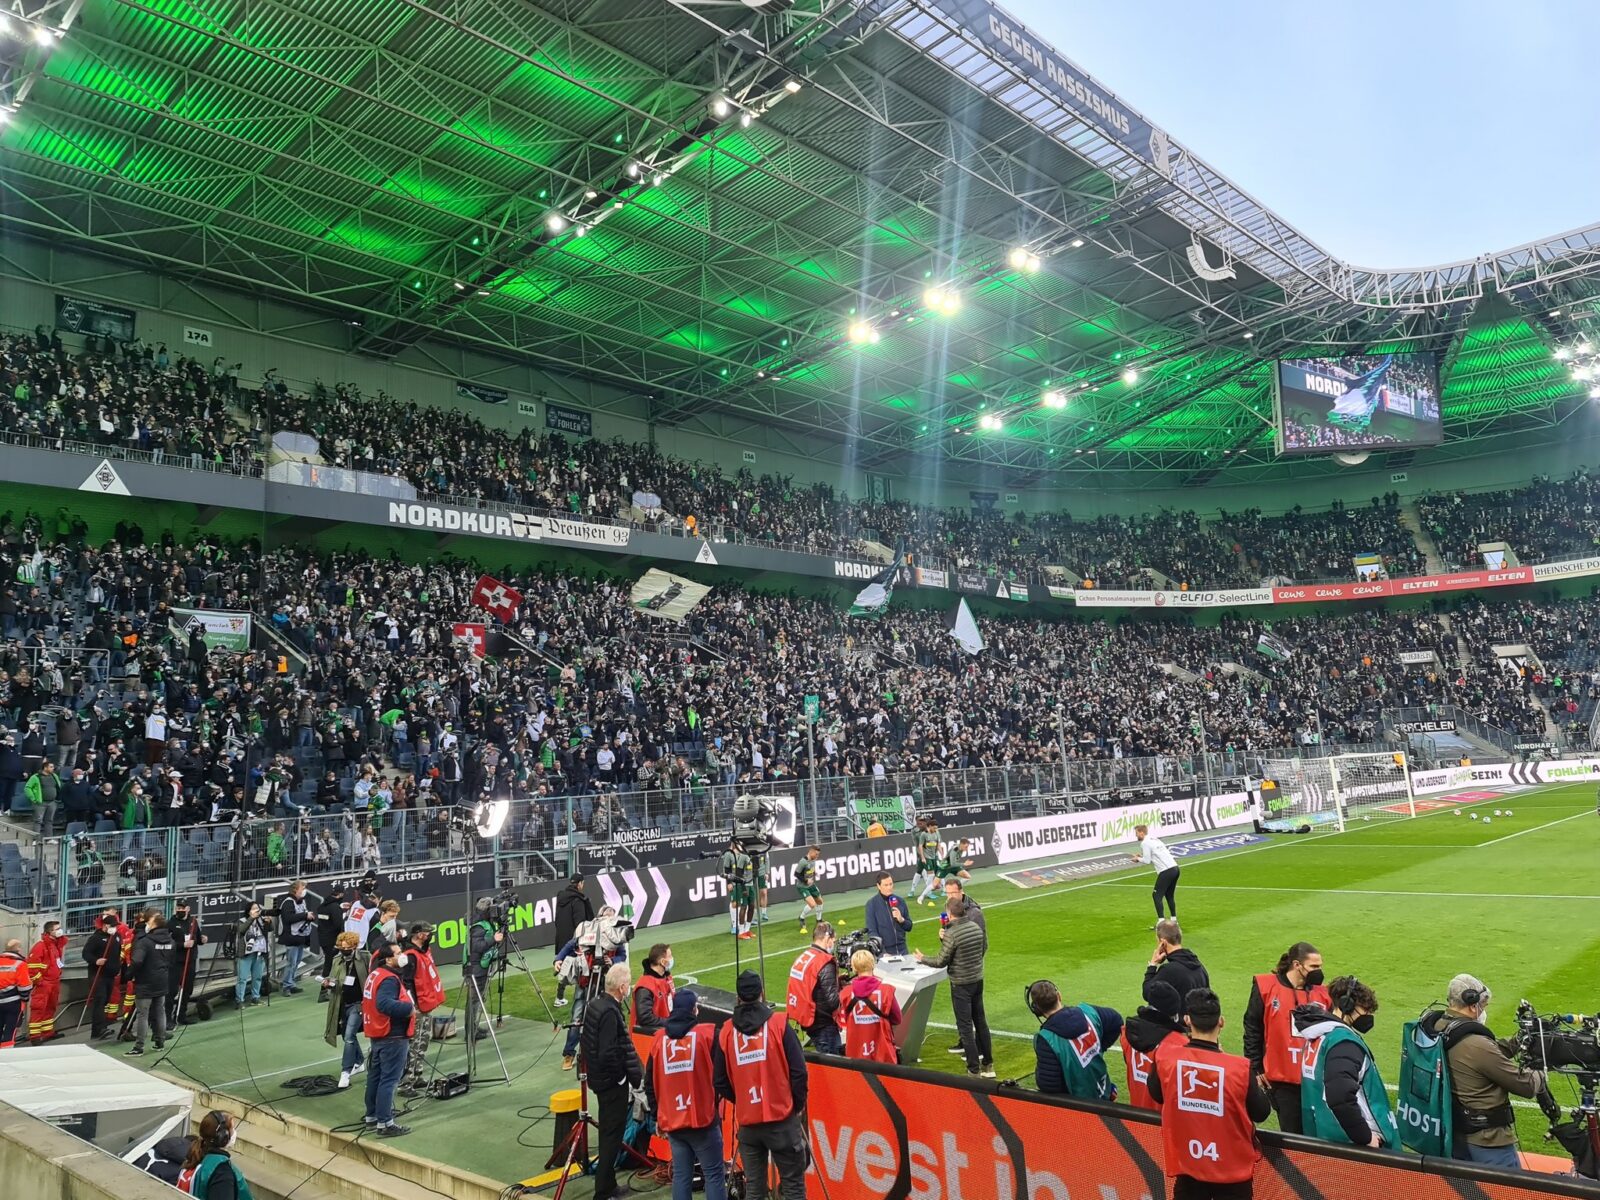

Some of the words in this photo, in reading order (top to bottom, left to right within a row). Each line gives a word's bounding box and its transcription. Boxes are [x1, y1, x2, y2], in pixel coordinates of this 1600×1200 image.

[989, 14, 1044, 71] GEGEN
[1046, 57, 1130, 135] RASSISMUS
[187, 330, 209, 342] 17A
[389, 502, 542, 540] NORDKUR
[1535, 563, 1584, 577] RHEINISCHE
[1488, 572, 1526, 582] ELTEN
[1352, 585, 1383, 595] cewe
[1402, 579, 1439, 590] ELTEN
[1219, 592, 1270, 603] SelectLine
[1279, 589, 1305, 599] cewe
[1315, 588, 1343, 597] cewe
[1097, 595, 1151, 603] Personalmanagement
[1472, 769, 1502, 781] SEIN!
[865, 799, 893, 809] SPIDER
[1008, 830, 1034, 850] UND
[1035, 822, 1097, 847] JEDERZEIT
[1101, 807, 1162, 842] UNZÄHMBAR
[1161, 811, 1186, 826] SEIN!
[613, 827, 661, 843] MONSCHAU
[708, 834, 731, 844] flatex
[631, 844, 657, 853] flatex
[671, 839, 695, 849] flatex
[440, 865, 474, 876] flatex
[388, 871, 424, 883] flatex
[152, 883, 162, 891] 18
[862, 1040, 875, 1056] 13
[1182, 1100, 1220, 1112] BUNDESLIGA
[1397, 1098, 1441, 1137] HOST
[1189, 1139, 1220, 1161] 04
